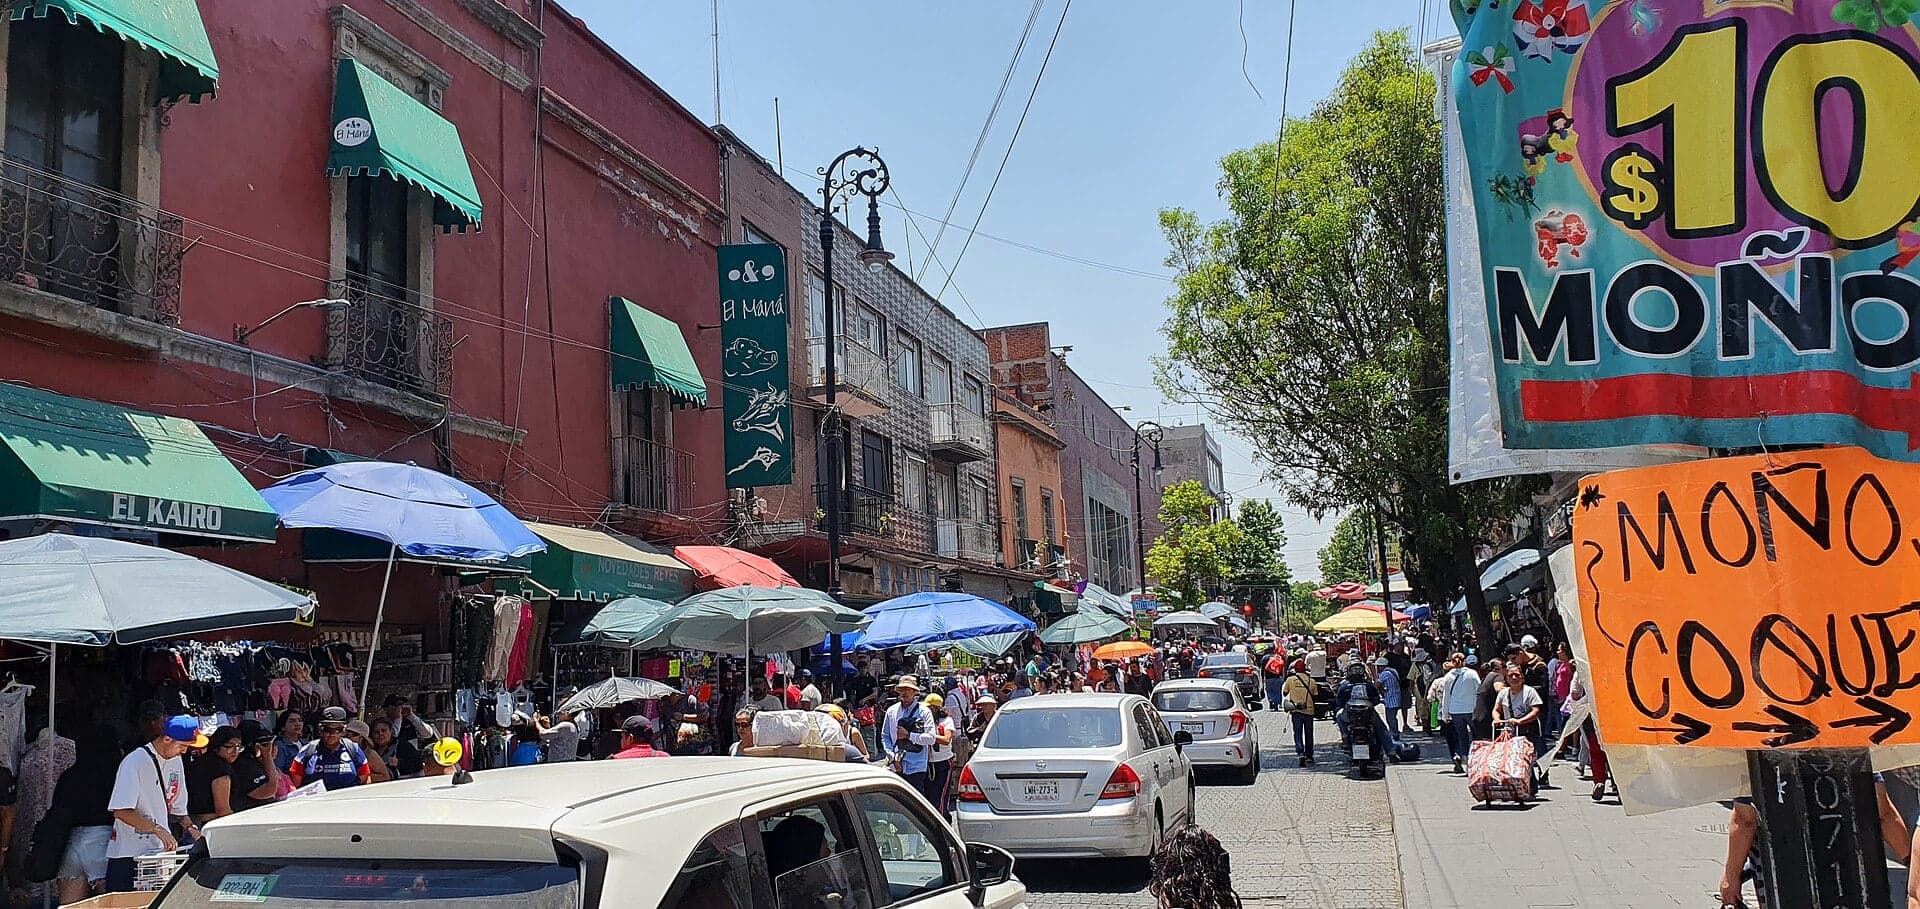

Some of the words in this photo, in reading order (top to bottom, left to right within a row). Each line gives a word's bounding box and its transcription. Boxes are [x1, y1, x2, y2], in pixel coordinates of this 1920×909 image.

[723, 299, 735, 321] El
[742, 293, 785, 319] Maná
[112, 493, 141, 521] EL
[147, 498, 222, 531] KAIRO
[597, 559, 651, 580] NOVEDADES
[653, 567, 681, 584] REYES
